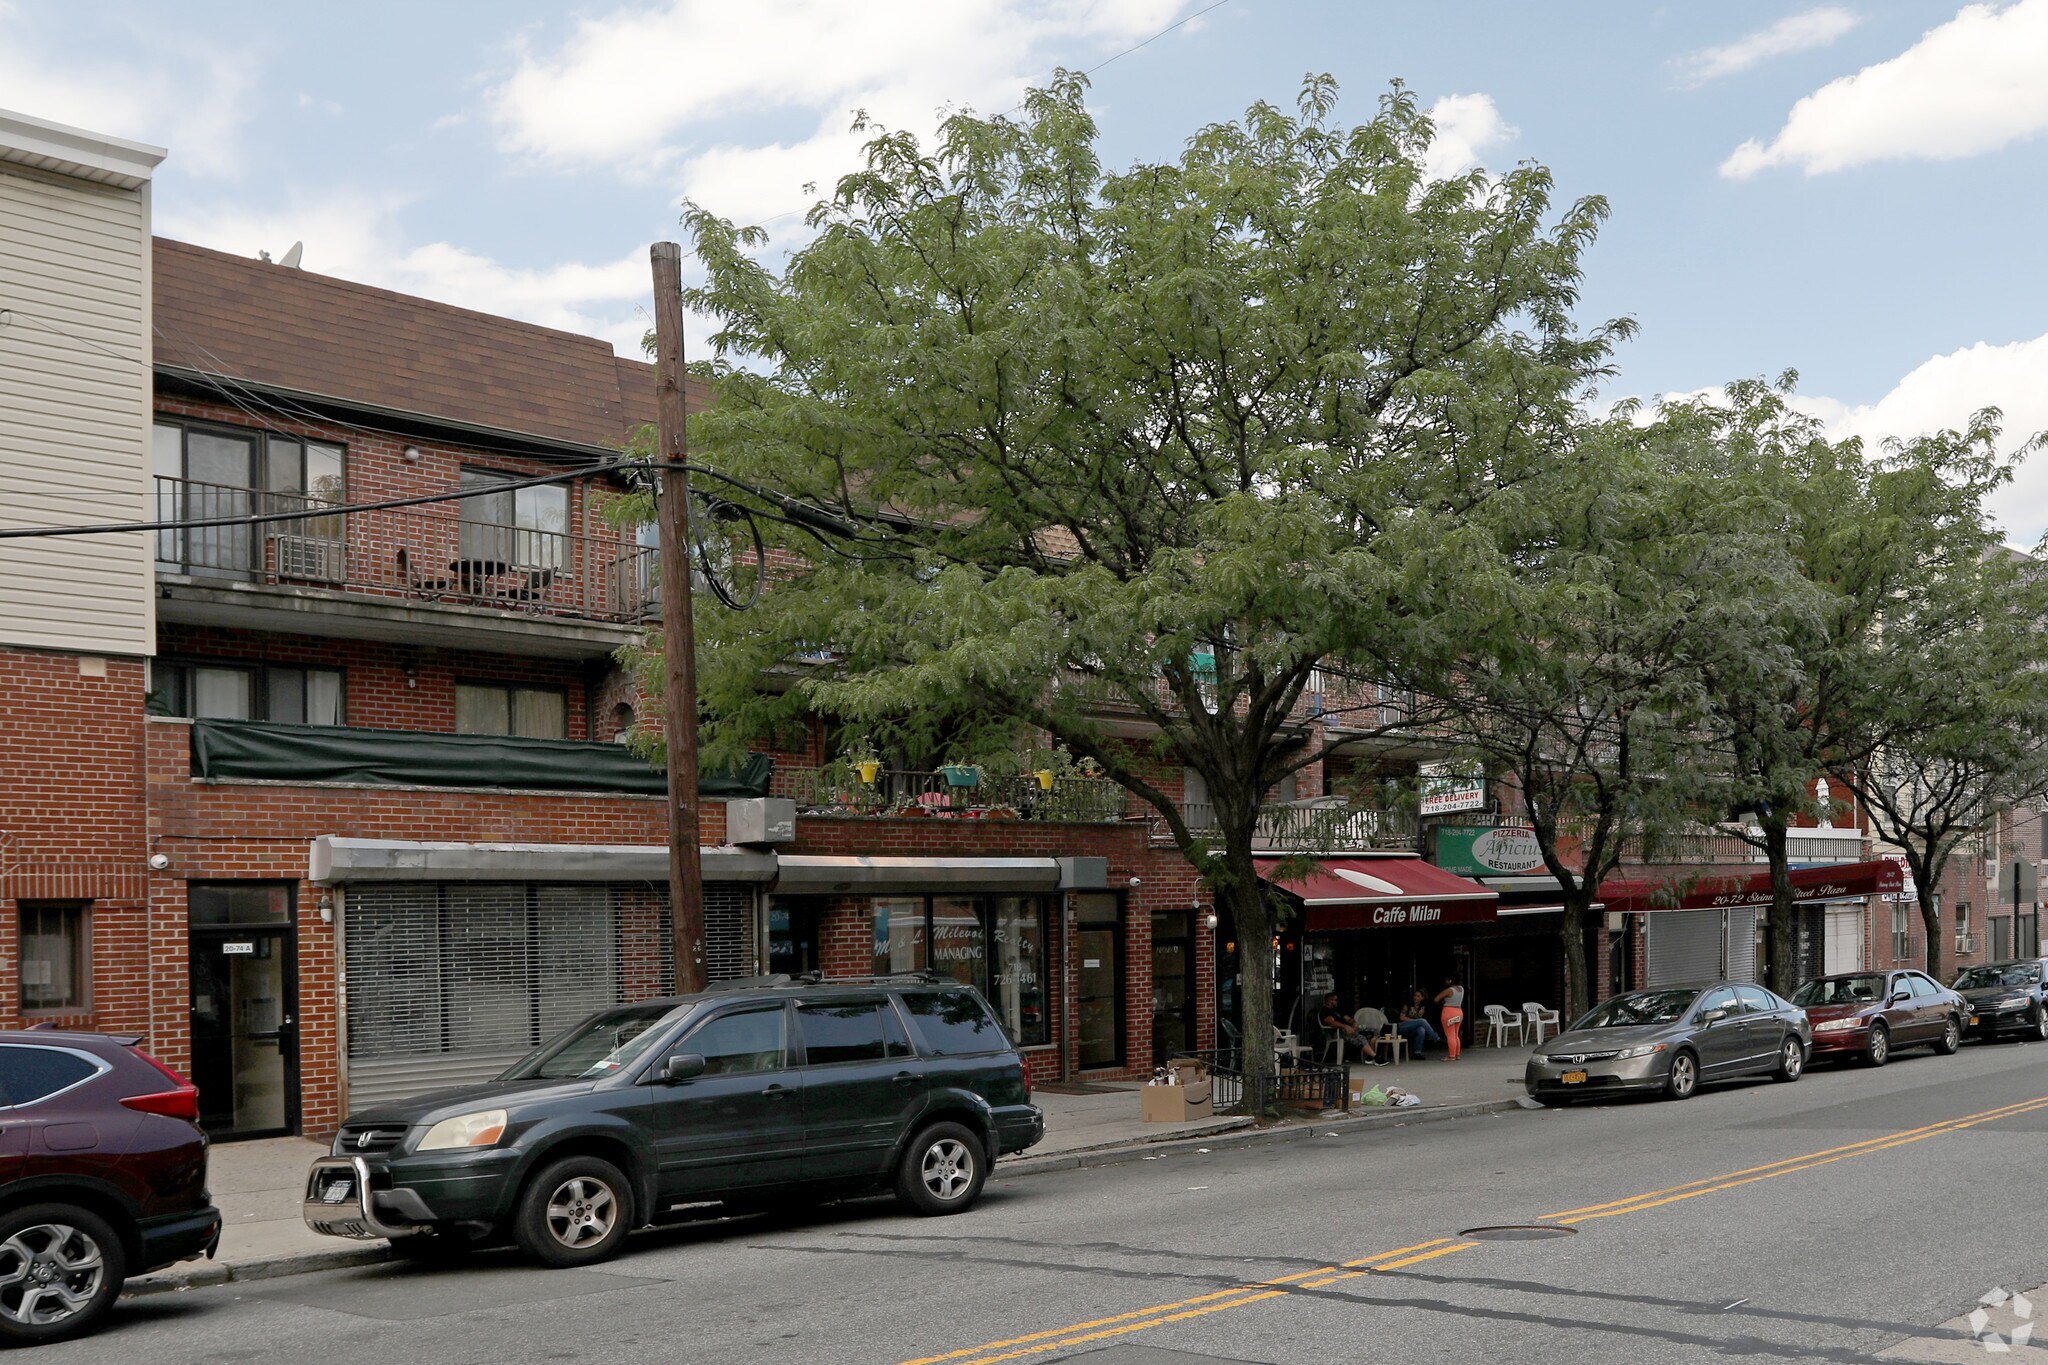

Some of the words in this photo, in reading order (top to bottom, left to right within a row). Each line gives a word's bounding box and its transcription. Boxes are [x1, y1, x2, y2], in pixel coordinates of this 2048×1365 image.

[1425, 796, 1443, 805] FREE
[1445, 792, 1479, 803] DELIVERY
[1425, 800, 1479, 812] 718-204-7722
[1492, 830, 1530, 838] PIZZERIA
[1488, 859, 1537, 871] RESTAURANT
[1712, 894, 1744, 905] 20-72
[1817, 883, 1847, 896] Plaza
[1373, 907, 1406, 923] Caffe
[1409, 905, 1441, 921] Milan
[910, 929, 924, 944] L.
[933, 926, 984, 940] Milevoi
[993, 929, 1034, 954] Realty
[934, 946, 983, 961] MANAGING
[1008, 963, 1022, 972] 718
